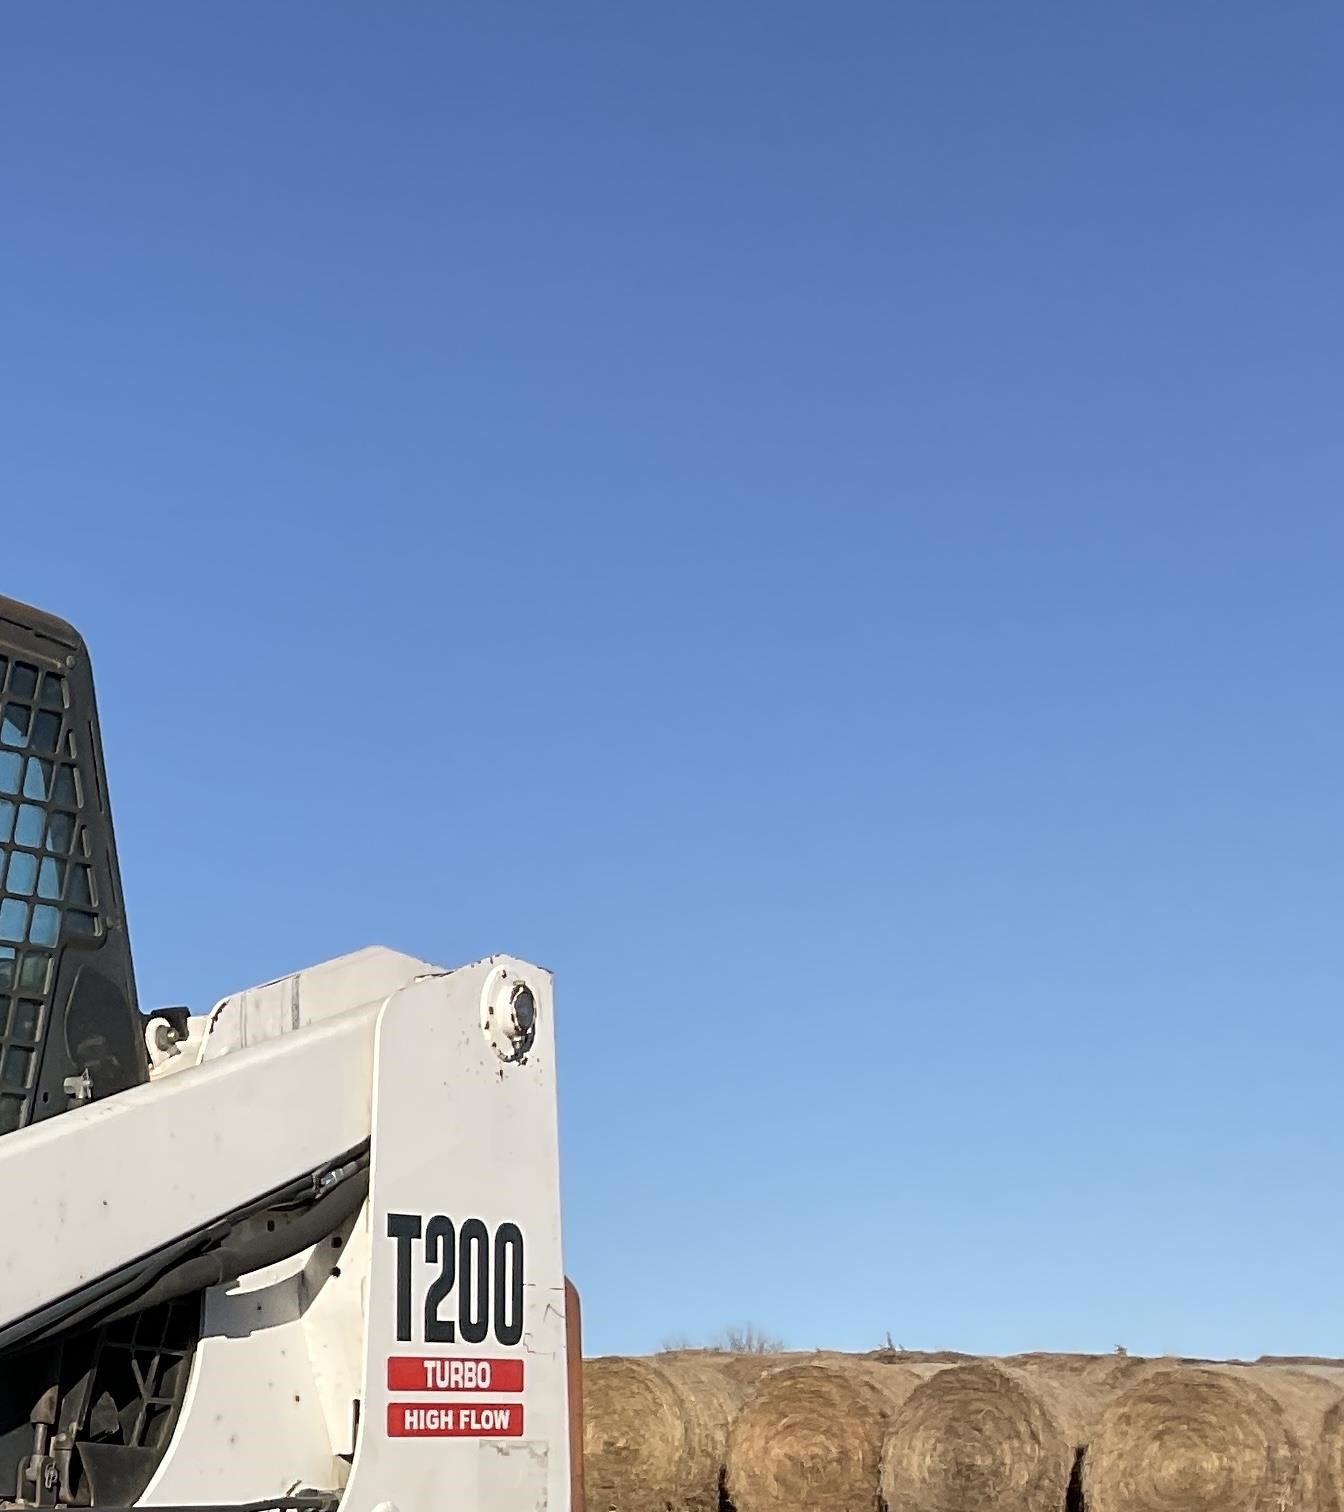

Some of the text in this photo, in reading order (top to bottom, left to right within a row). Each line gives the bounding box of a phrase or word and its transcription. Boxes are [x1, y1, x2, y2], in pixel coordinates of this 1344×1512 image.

[387, 1213, 524, 1346] T200
[424, 1360, 491, 1388] TURBO
[404, 1409, 510, 1430] HIGH FLOW
